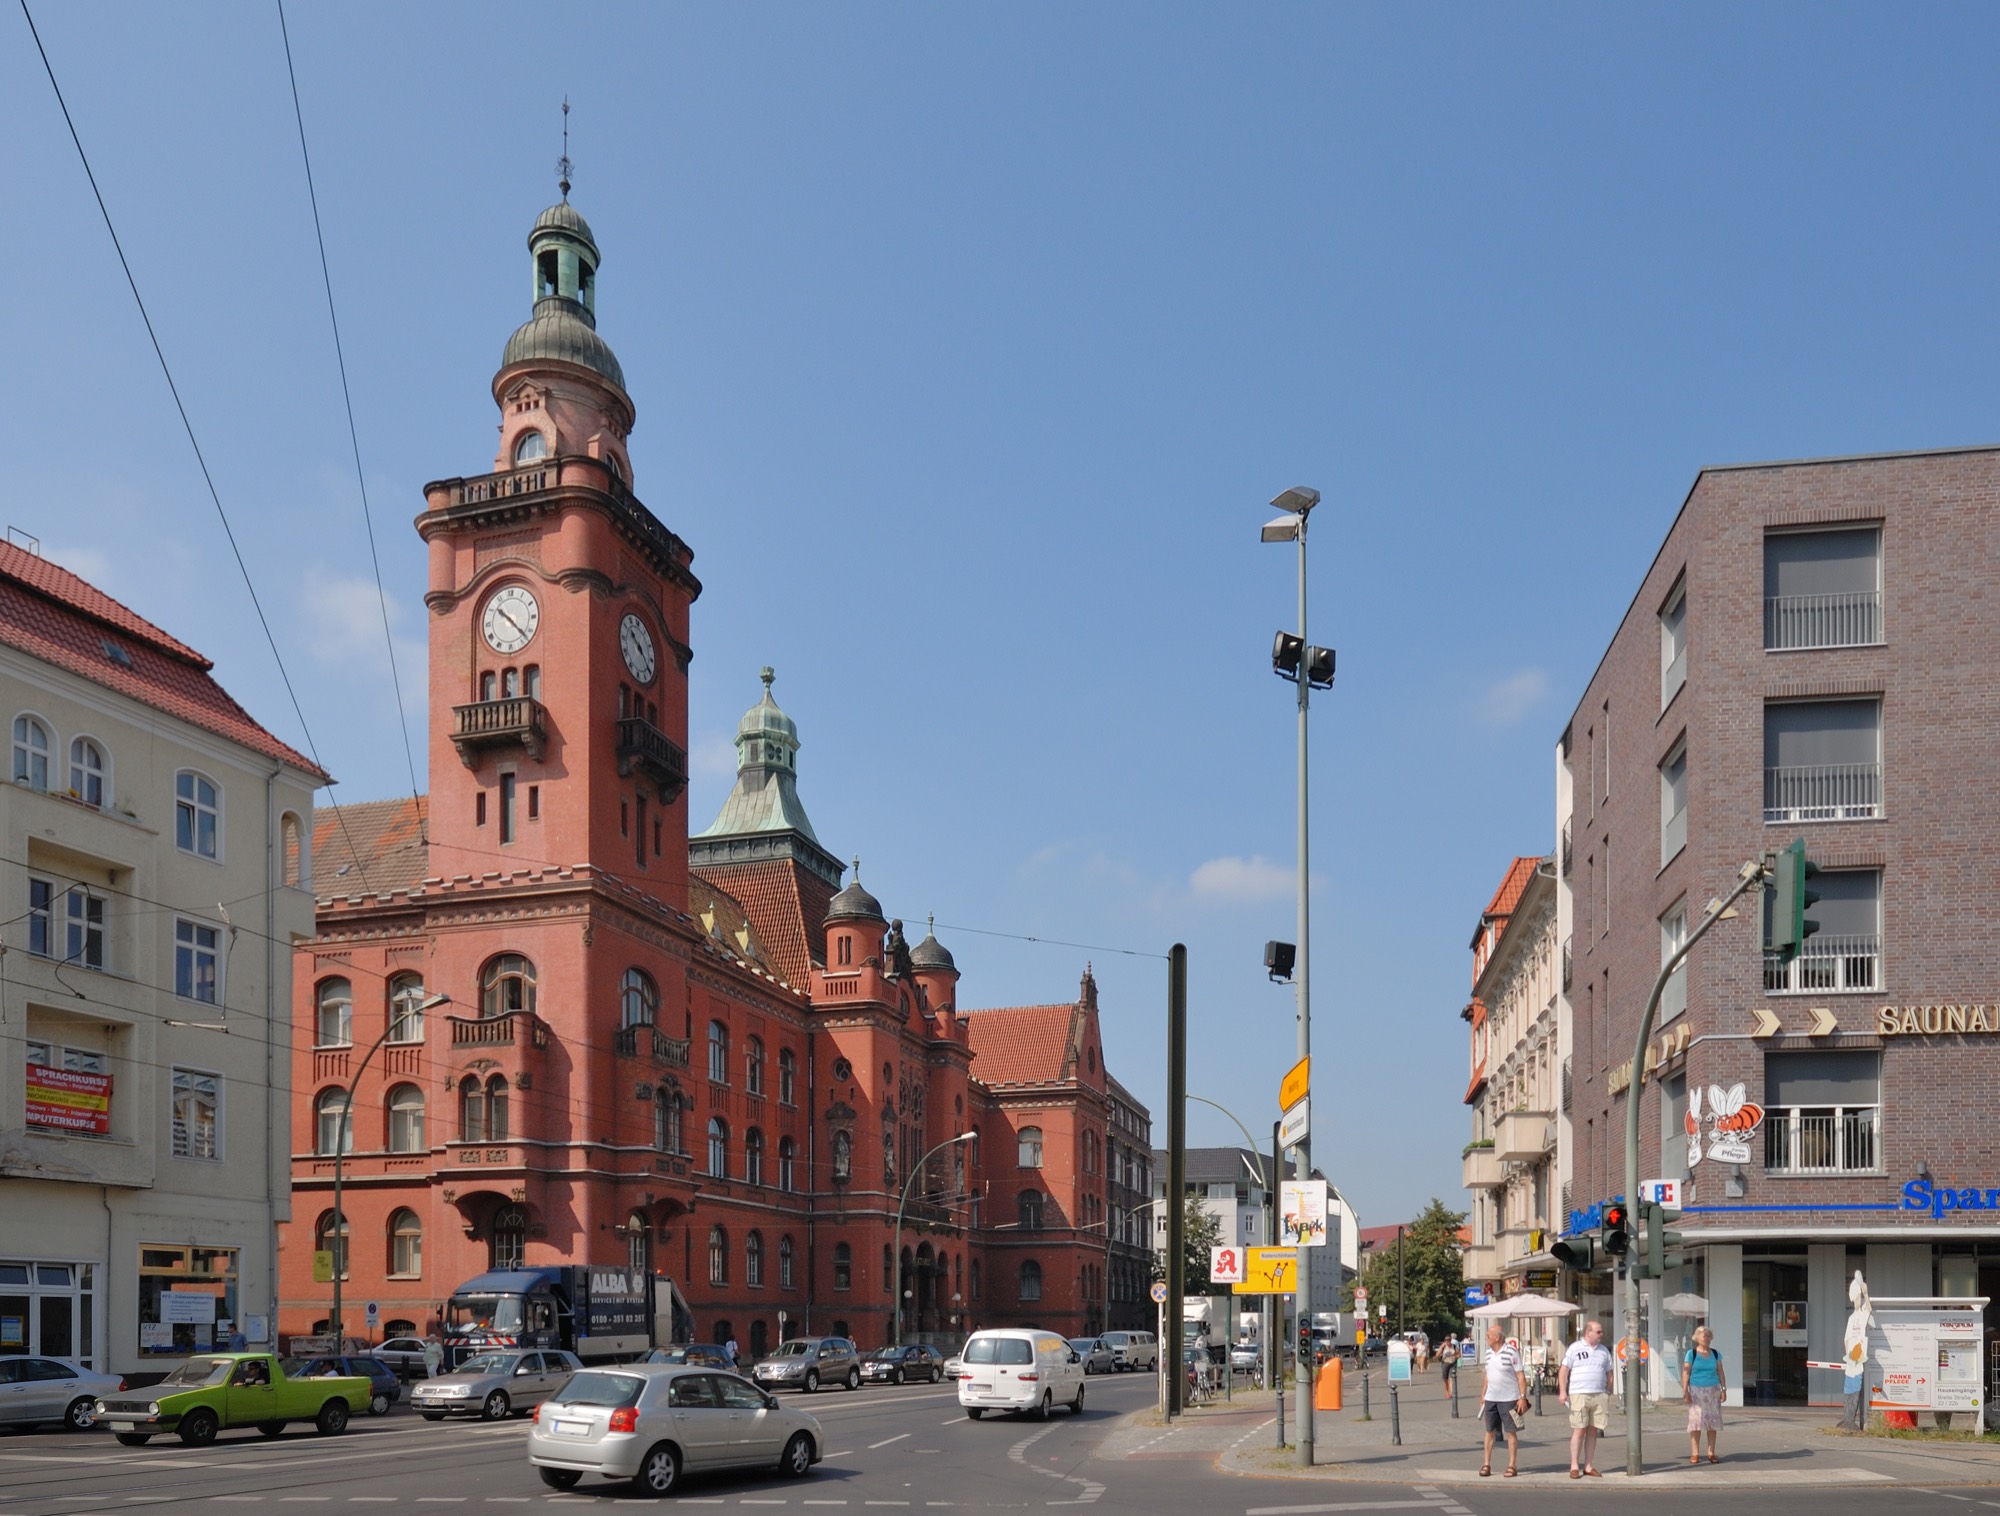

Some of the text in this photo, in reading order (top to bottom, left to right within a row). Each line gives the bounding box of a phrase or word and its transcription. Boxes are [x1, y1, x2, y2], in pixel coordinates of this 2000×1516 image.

[1878, 1004, 2000, 1035] SAUNA
[36, 1068, 108, 1087] SPRACHKURSE
[42, 1078, 68, 1088] Spanisch
[71, 1110, 93, 1118] Internet
[1722, 1150, 1746, 1159] Pflege
[591, 1273, 628, 1293] ALBA
[591, 1315, 607, 1324] 0180
[613, 1314, 624, 1323] 351
[634, 1314, 645, 1322] 351
